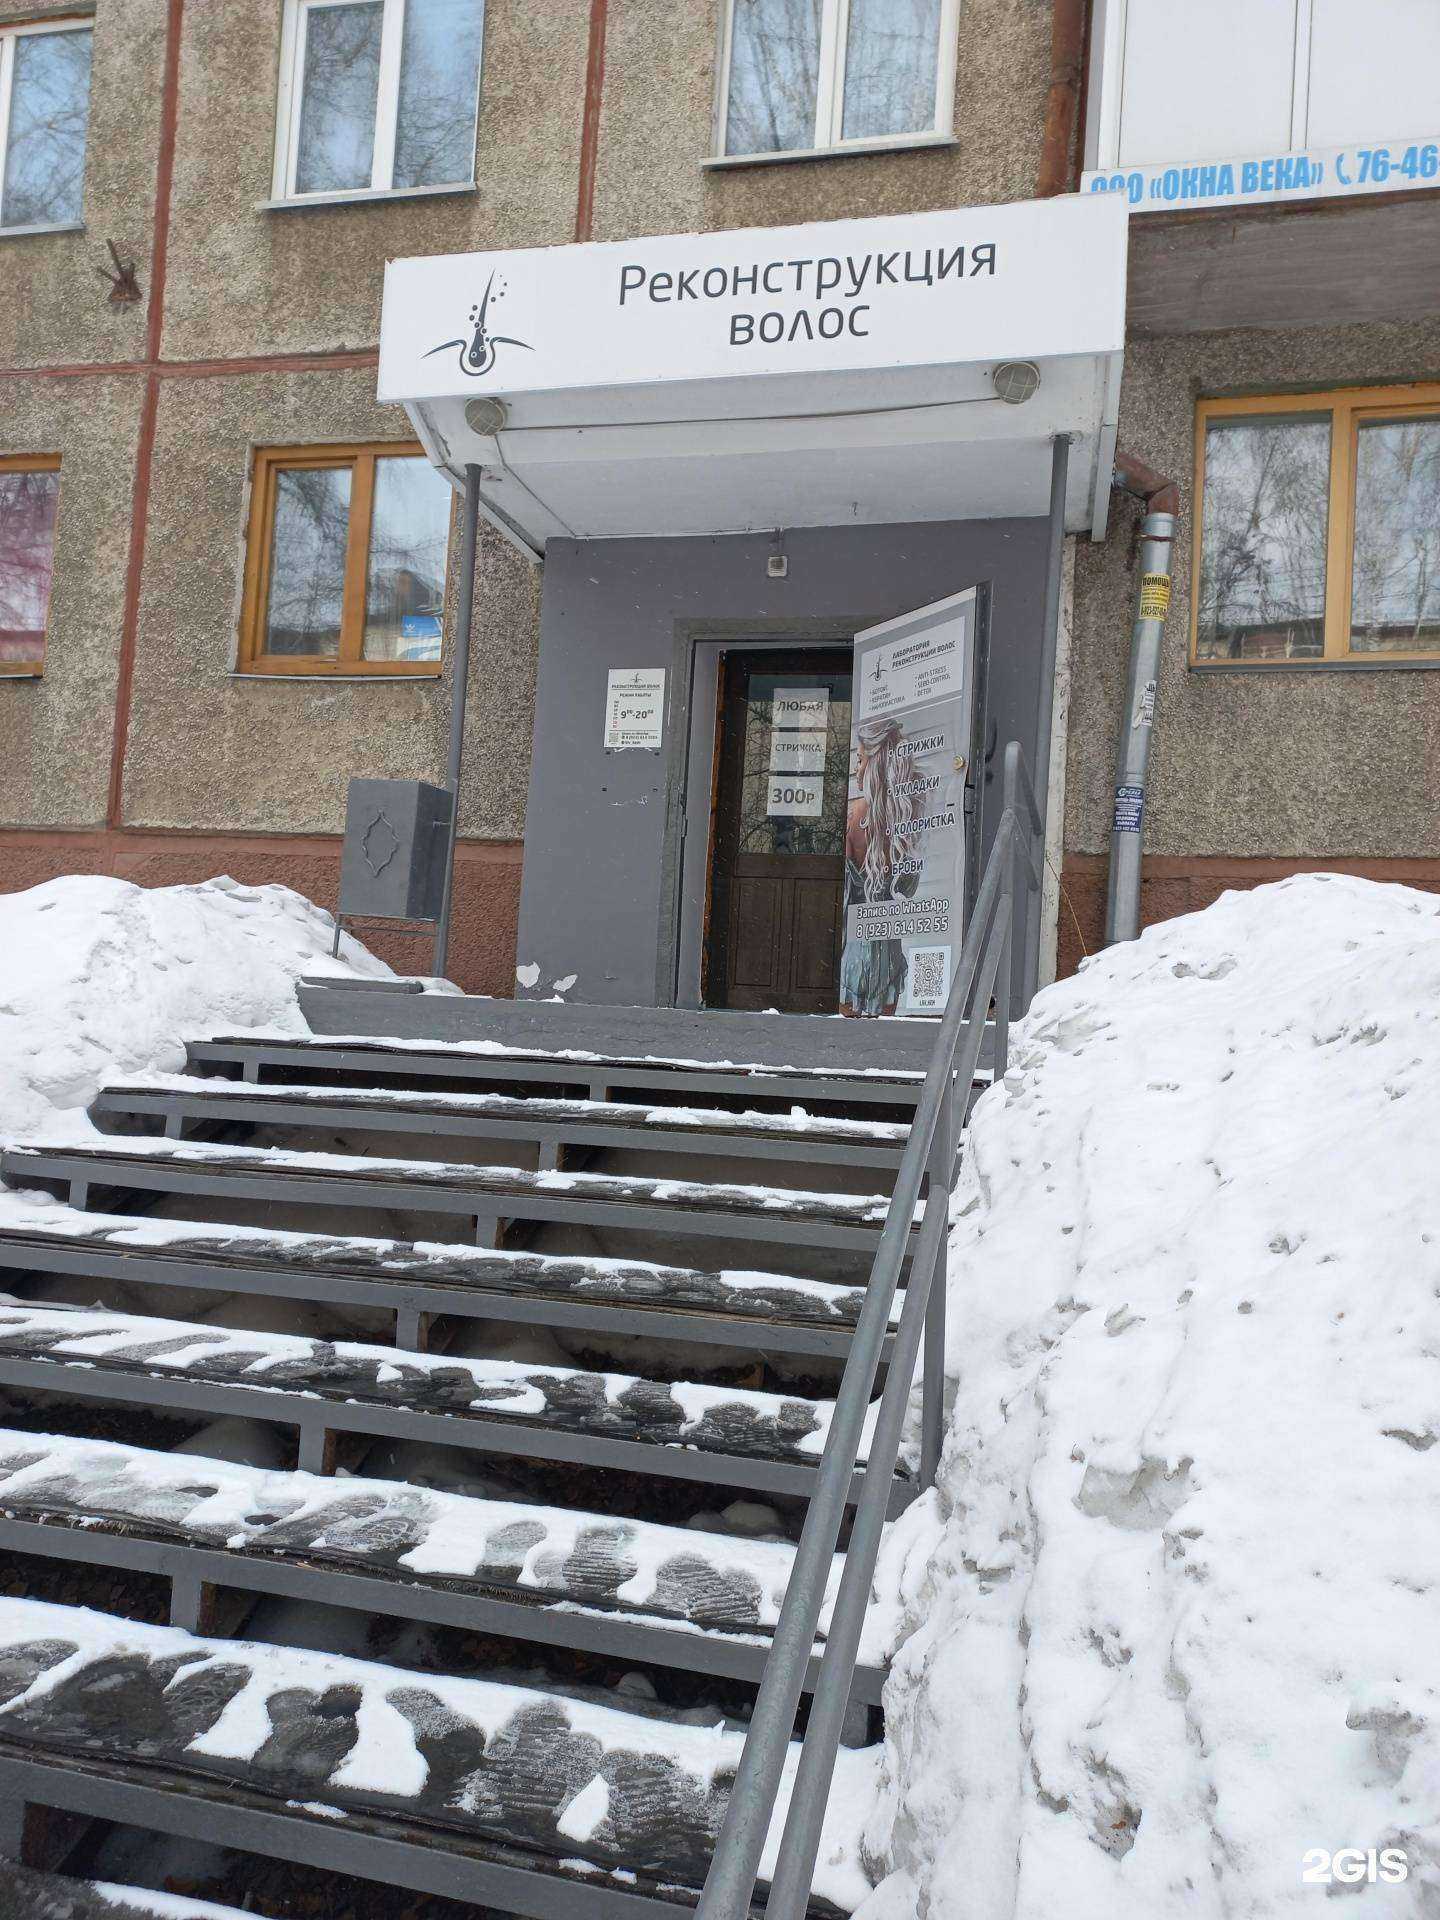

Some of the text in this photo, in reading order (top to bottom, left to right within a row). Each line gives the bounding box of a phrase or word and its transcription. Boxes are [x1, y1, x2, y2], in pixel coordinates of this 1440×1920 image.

[1357, 144, 1440, 184] 76-46
[619, 243, 997, 306] Реконструкция
[729, 304, 871, 346] волос
[892, 640, 930, 659] ЛАБОРАТОРИЯ
[937, 640, 956, 653] ВОЛОС
[777, 701, 824, 712] ЛЮБАЯ
[775, 743, 822, 753] СТРИЖКА
[897, 735, 945, 758] СТРИЖКИ
[894, 775, 940, 797] УКЛАДКИ
[893, 812, 955, 836] КОЛОРИСТКА
[892, 859, 924, 876] БРОВИ
[857, 897, 950, 919] Запись по WhatsApp
[856, 916, 948, 940] 8 (923) 614 52 55
